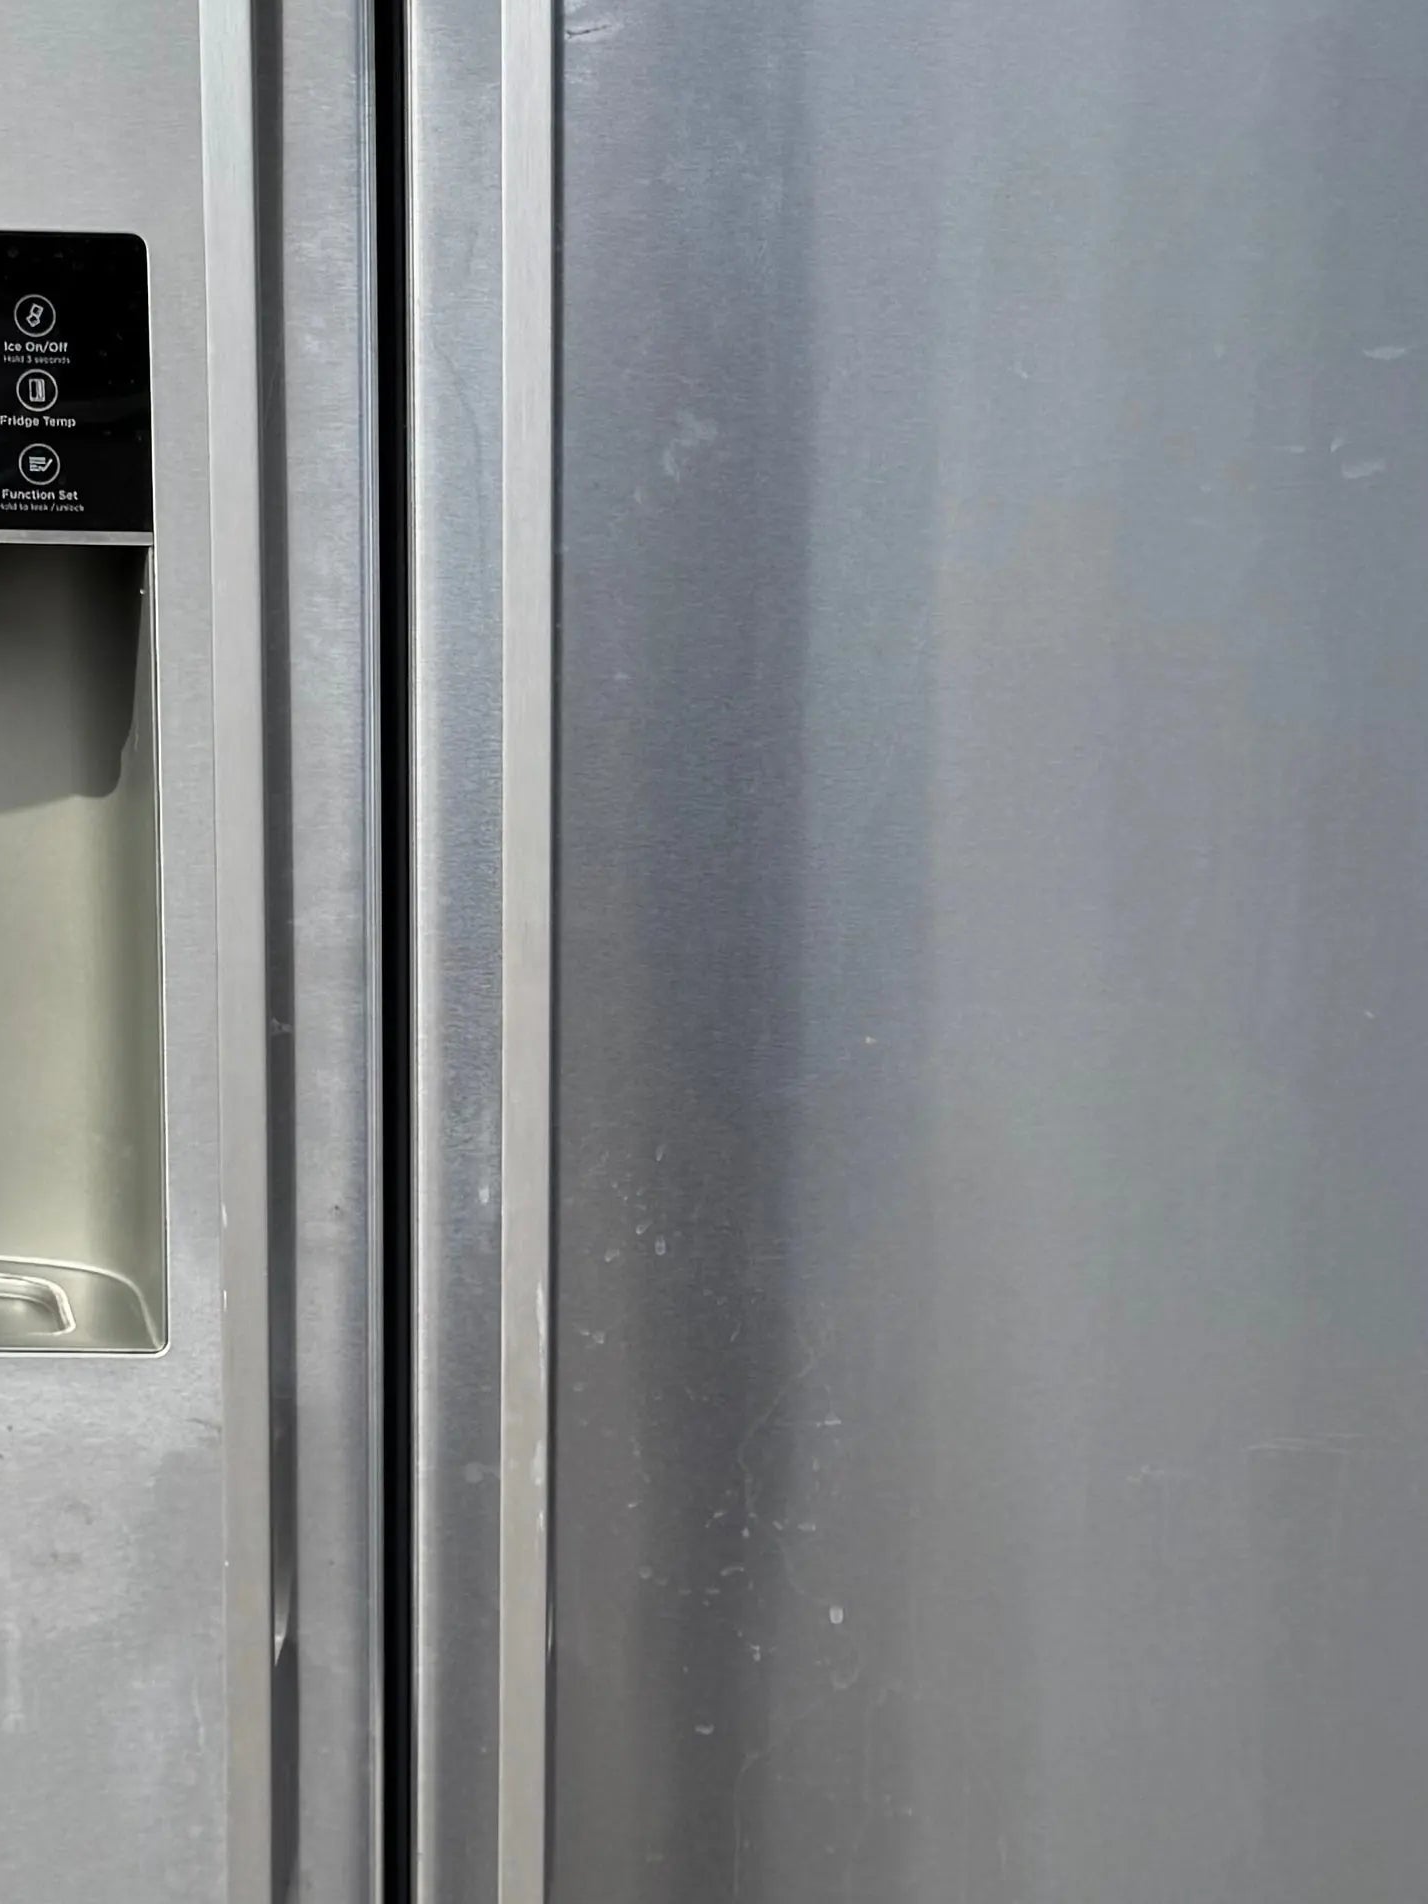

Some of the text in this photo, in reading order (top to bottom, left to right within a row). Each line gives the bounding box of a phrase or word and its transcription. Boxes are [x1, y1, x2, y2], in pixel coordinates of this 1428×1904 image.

[4, 341, 68, 353] Ice On/Off
[0, 415, 76, 428] Fridge Temp
[2, 488, 79, 500] Function Set
